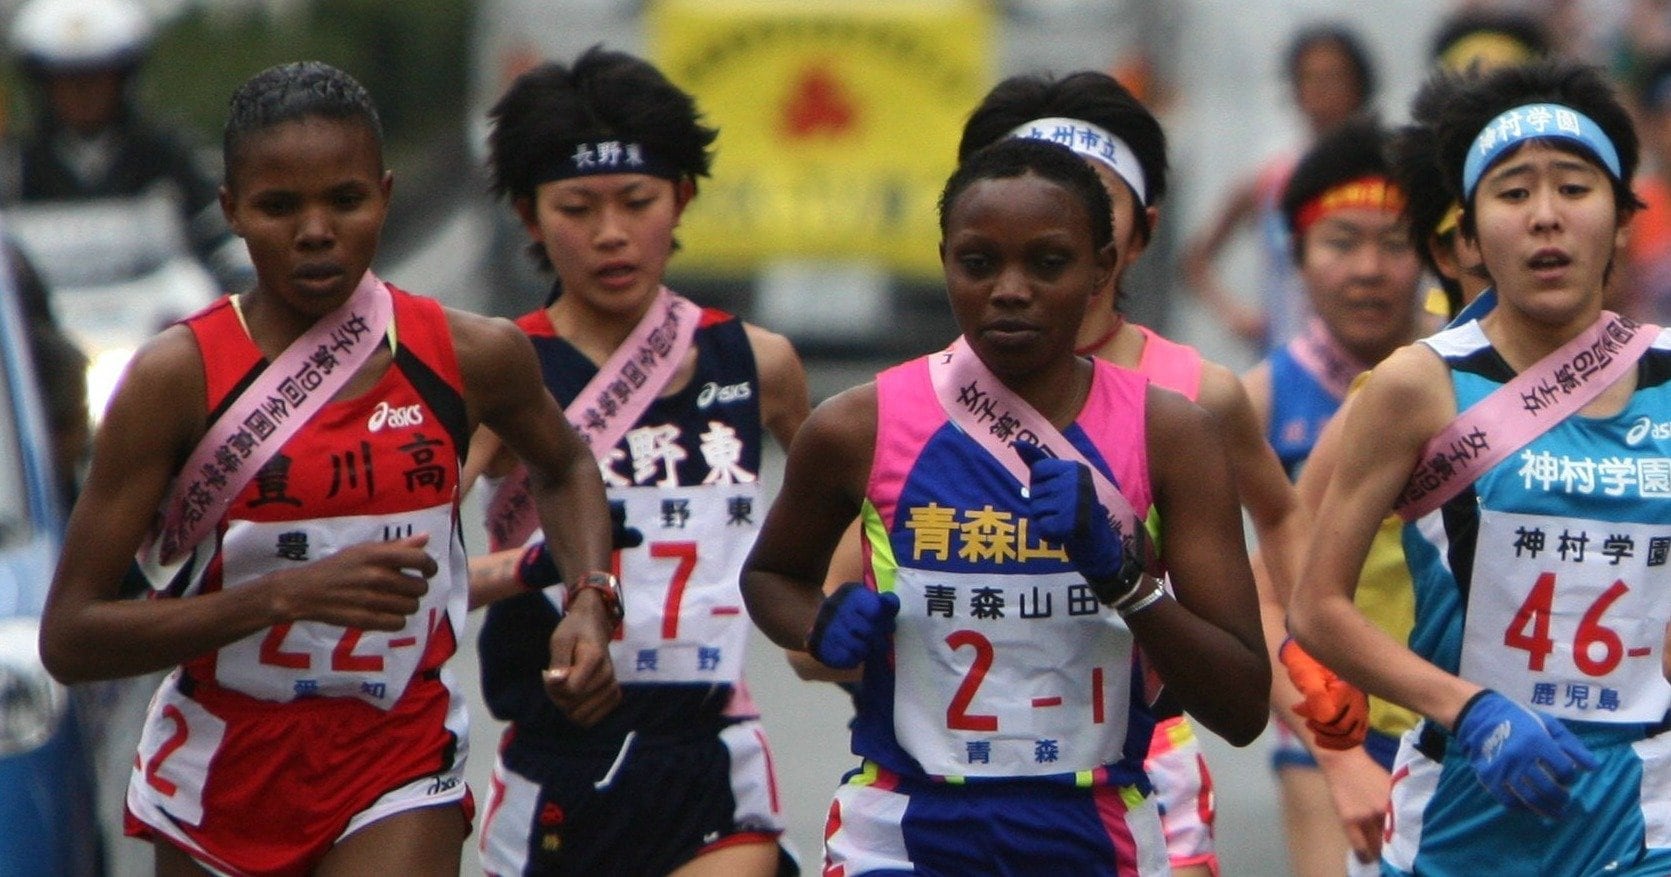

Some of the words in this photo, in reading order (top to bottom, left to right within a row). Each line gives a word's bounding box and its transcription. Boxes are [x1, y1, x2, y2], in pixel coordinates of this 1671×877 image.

[1479, 106, 1580, 155] 神村学園
[571, 140, 644, 168] 長野東
[368, 401, 423, 432] asics
[1518, 450, 1671, 498] 神村学園
[923, 584, 1099, 620] 青森山田
[636, 649, 721, 671] 長野
[1530, 681, 1621, 712] 鹿児島
[966, 739, 1059, 764] 青森
